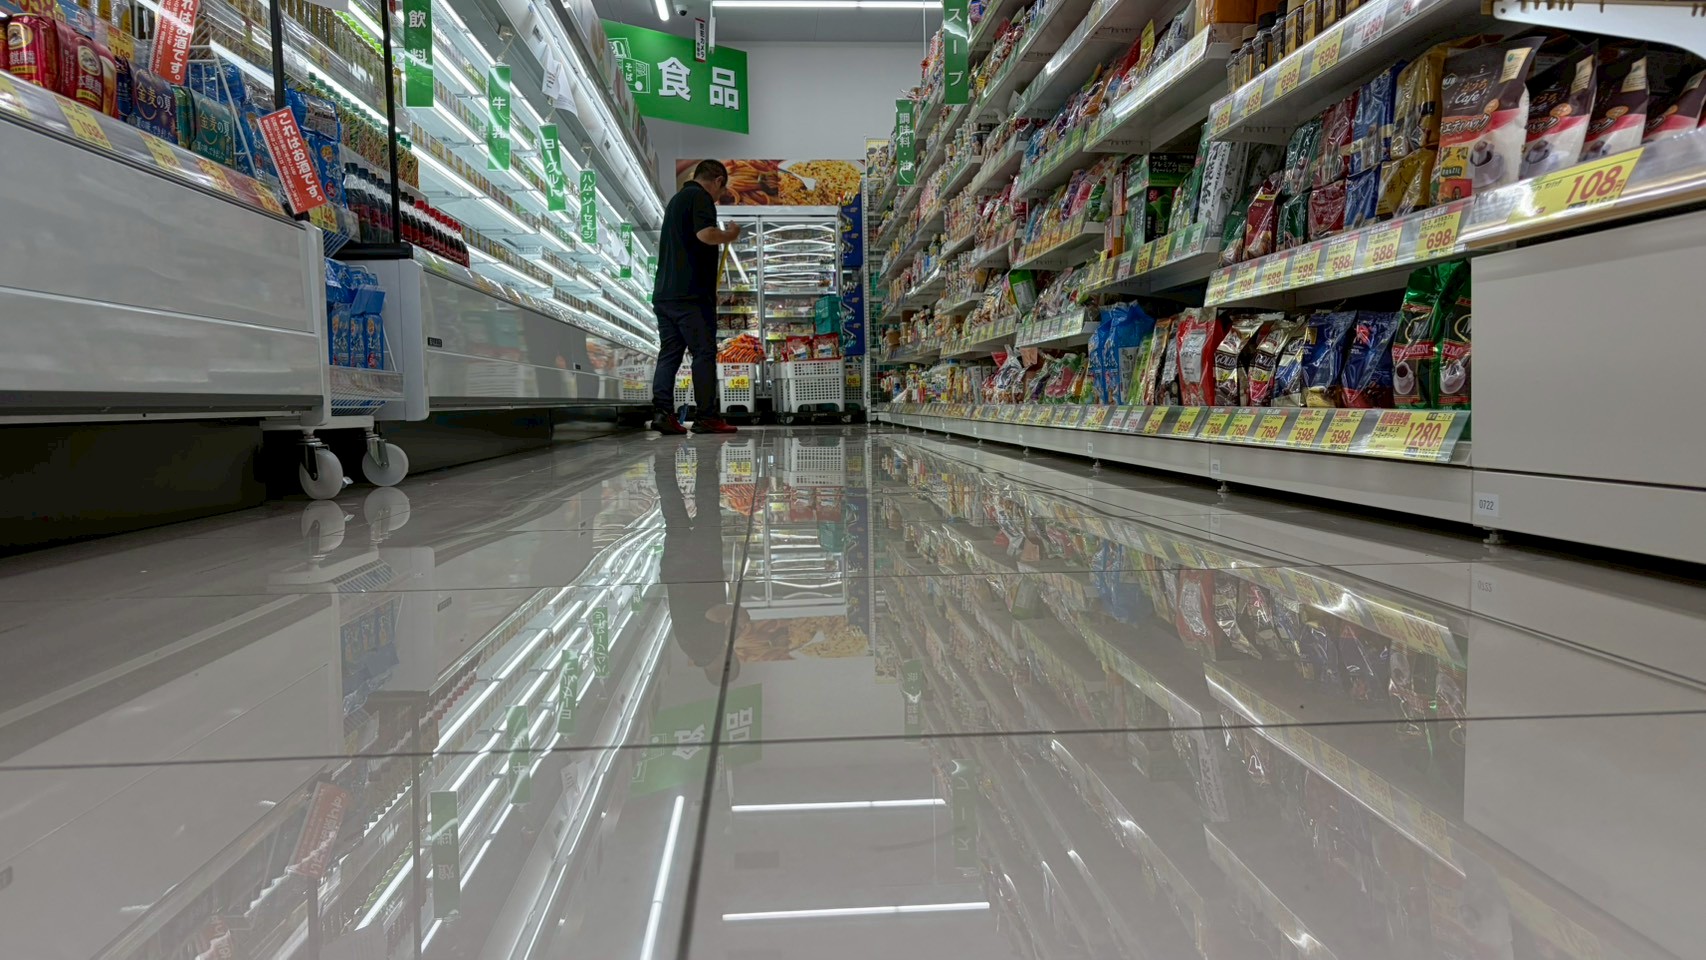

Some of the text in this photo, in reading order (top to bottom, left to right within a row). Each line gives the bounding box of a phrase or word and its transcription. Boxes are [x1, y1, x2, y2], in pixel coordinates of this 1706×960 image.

[408, 10, 427, 66] 飲料
[948, 8, 963, 86] スープ
[136, 82, 173, 115] 金麦の夏
[657, 57, 740, 110] 食品
[199, 111, 231, 138] 金麦の夏
[492, 97, 507, 139] 牛乳
[278, 112, 323, 202] これはお酒です。
[544, 138, 563, 197] ヨーグルト
[582, 174, 596, 239] ハム・ソーセージ
[1372, 243, 1394, 262] 588
[1426, 228, 1452, 250] 698
[1332, 253, 1351, 271] 588
[1260, 426, 1278, 438] 768
[1295, 427, 1314, 441] 598
[1330, 430, 1351, 443] 598
[1479, 499, 1494, 511] 0722
